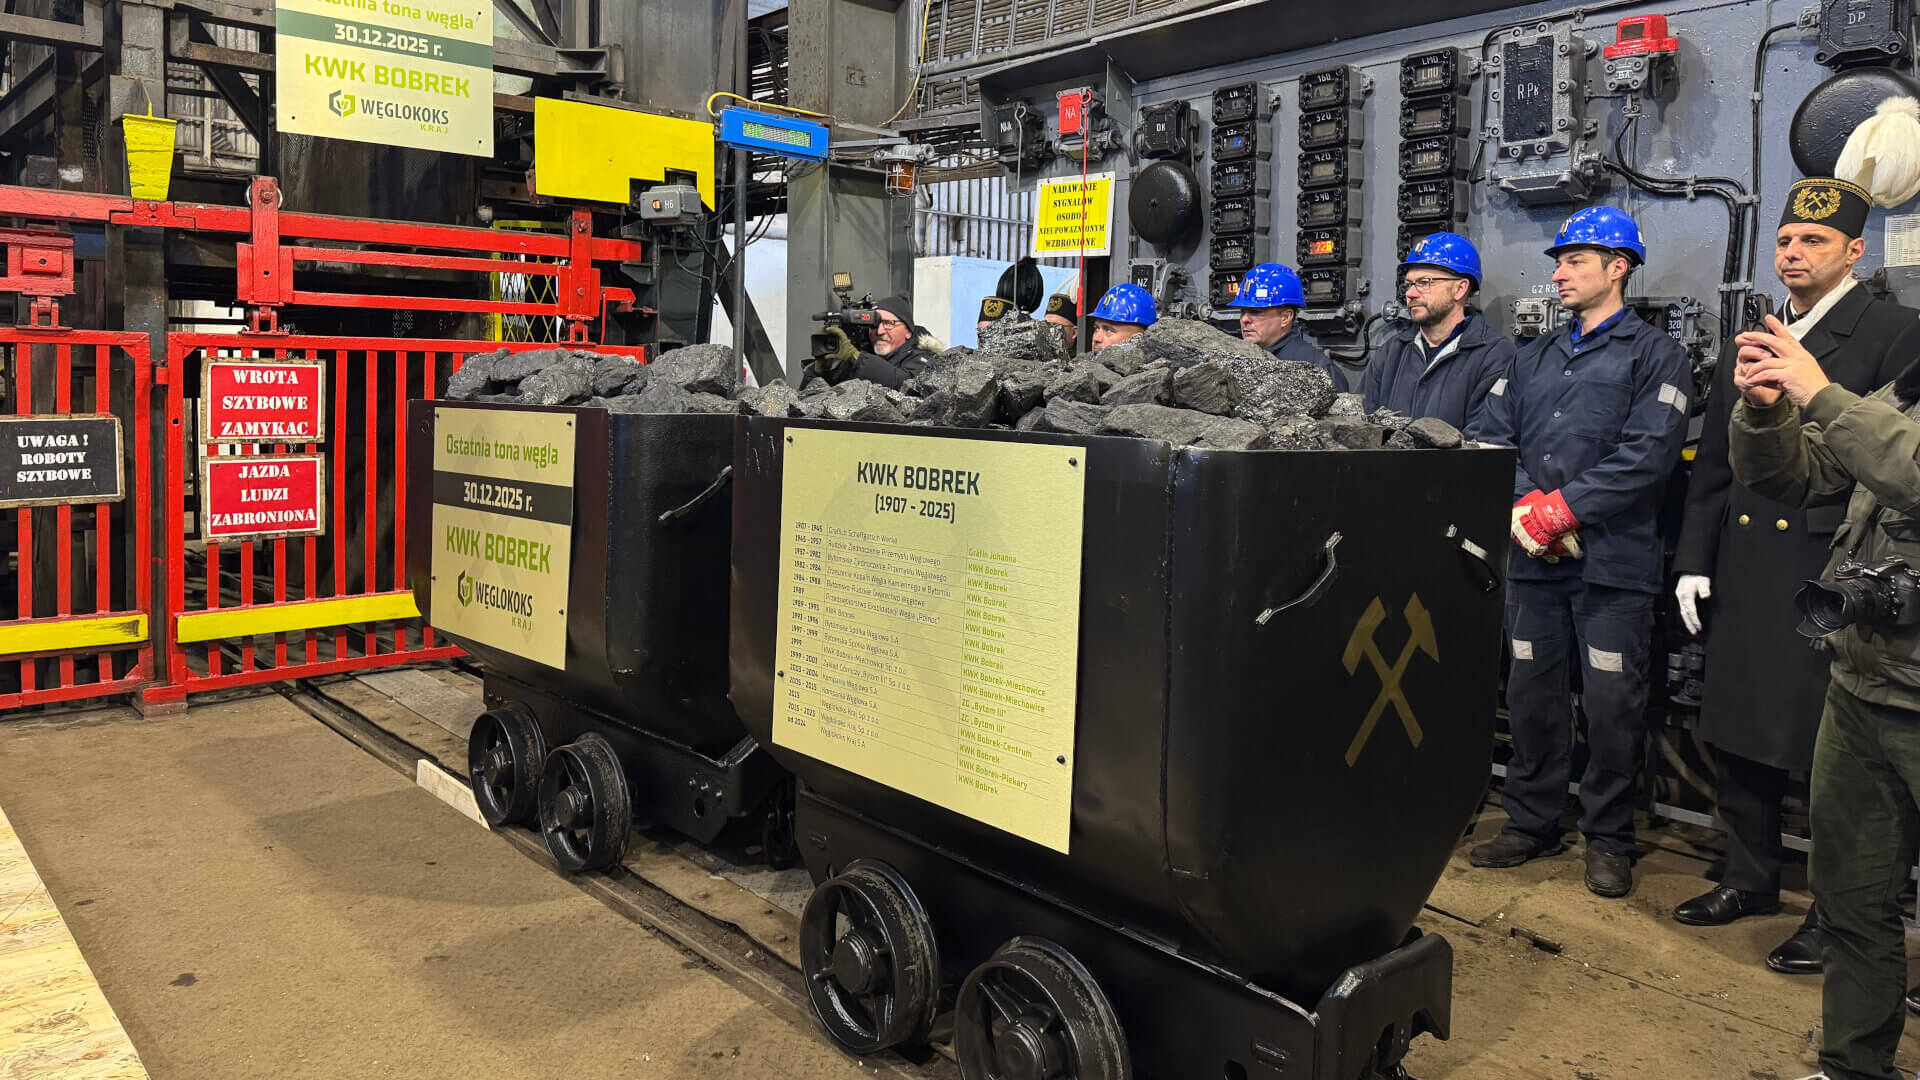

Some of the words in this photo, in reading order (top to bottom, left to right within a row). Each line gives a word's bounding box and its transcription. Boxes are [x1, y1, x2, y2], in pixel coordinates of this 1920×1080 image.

[383, 0, 421, 19] tona
[426, 9, 474, 30] węgla
[1847, 11, 1866, 25] DP
[334, 23, 429, 54] 30.12.2025
[433, 43, 444, 57] r.
[305, 53, 366, 83] KWK
[374, 64, 471, 99] BOBREK
[360, 98, 449, 125] WĘGLOKOKS
[420, 123, 449, 134] KRAJ
[1668, 320, 1681, 330] 320
[232, 369, 299, 385] WROTA
[222, 396, 308, 411] SZYBOWE
[17, 435, 77, 448] UWAGA
[83, 434, 89, 447] !
[21, 451, 88, 466] ROBOTY
[446, 433, 491, 458] Ostatnia
[494, 441, 520, 462] tona
[523, 443, 559, 470] węgla
[16, 468, 92, 483] SZYBOWE
[238, 464, 290, 479] JAZDA
[857, 461, 898, 486] KWK
[903, 465, 980, 495] BOBREK
[241, 488, 289, 503] LUDZI
[463, 481, 523, 511] 30.12.2025
[525, 492, 533, 512] r.
[211, 508, 316, 527] ZABRONIONA
[446, 524, 480, 560] KWK
[485, 532, 551, 574] BOBREK
[967, 563, 982, 573] KWK
[967, 578, 982, 588] KWK
[475, 580, 533, 617] WĘGLOKOKS
[966, 593, 981, 603] KWK
[966, 608, 981, 618] KWK
[511, 615, 532, 631] KRAJ
[965, 622, 980, 633] KWK
[964, 638, 979, 649] KWK
[964, 653, 979, 664] KWK
[963, 668, 978, 679] KWK
[962, 683, 977, 695] KWK
[960, 728, 975, 740] KWK
[959, 743, 974, 756] KWK
[959, 758, 974, 771] KWK
[958, 774, 973, 787] KWK
